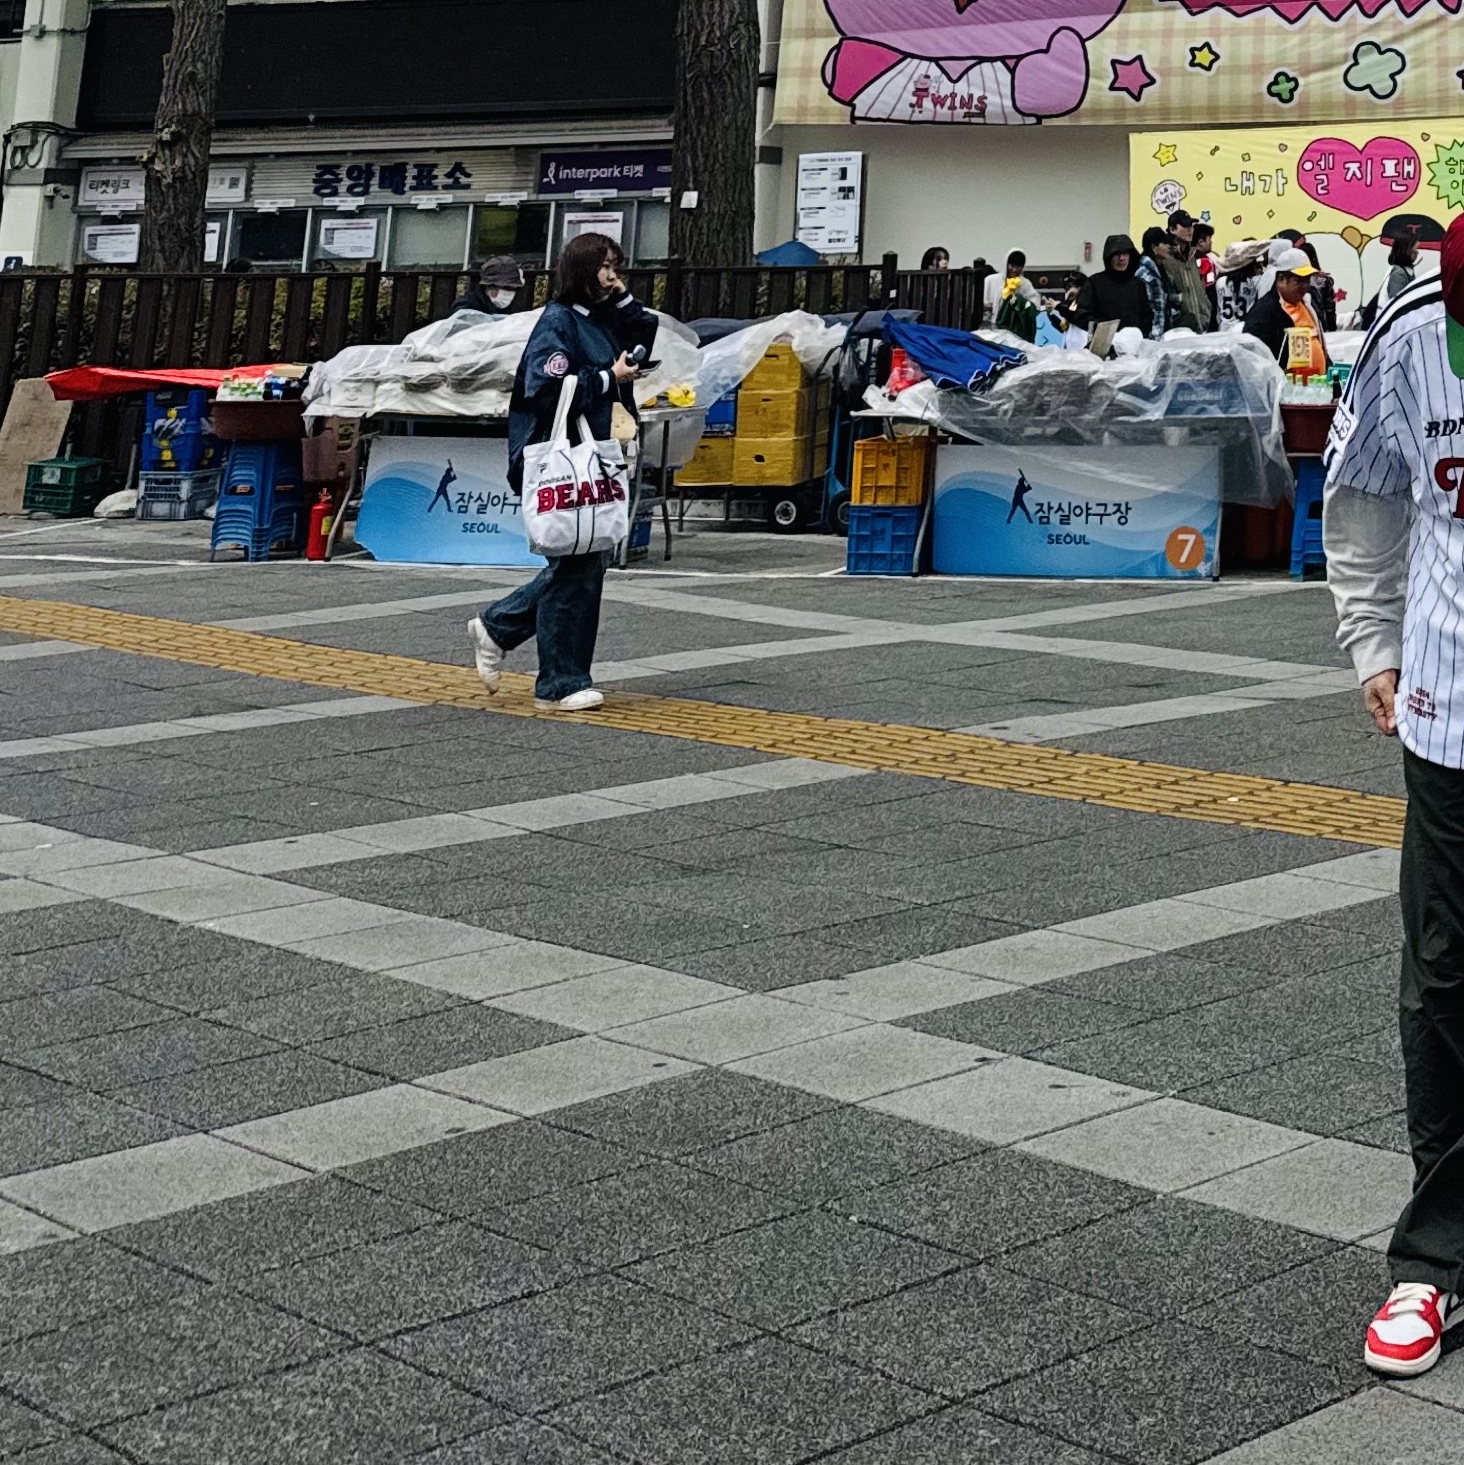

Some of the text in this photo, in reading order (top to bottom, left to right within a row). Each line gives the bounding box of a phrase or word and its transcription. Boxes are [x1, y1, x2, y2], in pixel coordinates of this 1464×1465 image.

[911, 88, 988, 112] TWINS
[312, 161, 474, 196] 중앙매표소
[558, 164, 621, 183] interpark
[623, 164, 645, 178] 티켓
[1224, 168, 1289, 197] 내가
[1302, 152, 1416, 195] 엘지팬
[1222, 296, 1248, 319] 53
[455, 491, 523, 516] 잠실야구
[537, 478, 627, 516] BEARS
[1034, 501, 1133, 526] 잠실야구장
[461, 522, 502, 534] SEOUL
[1046, 532, 1091, 546] SEOUL
[1177, 533, 1197, 564] 7
